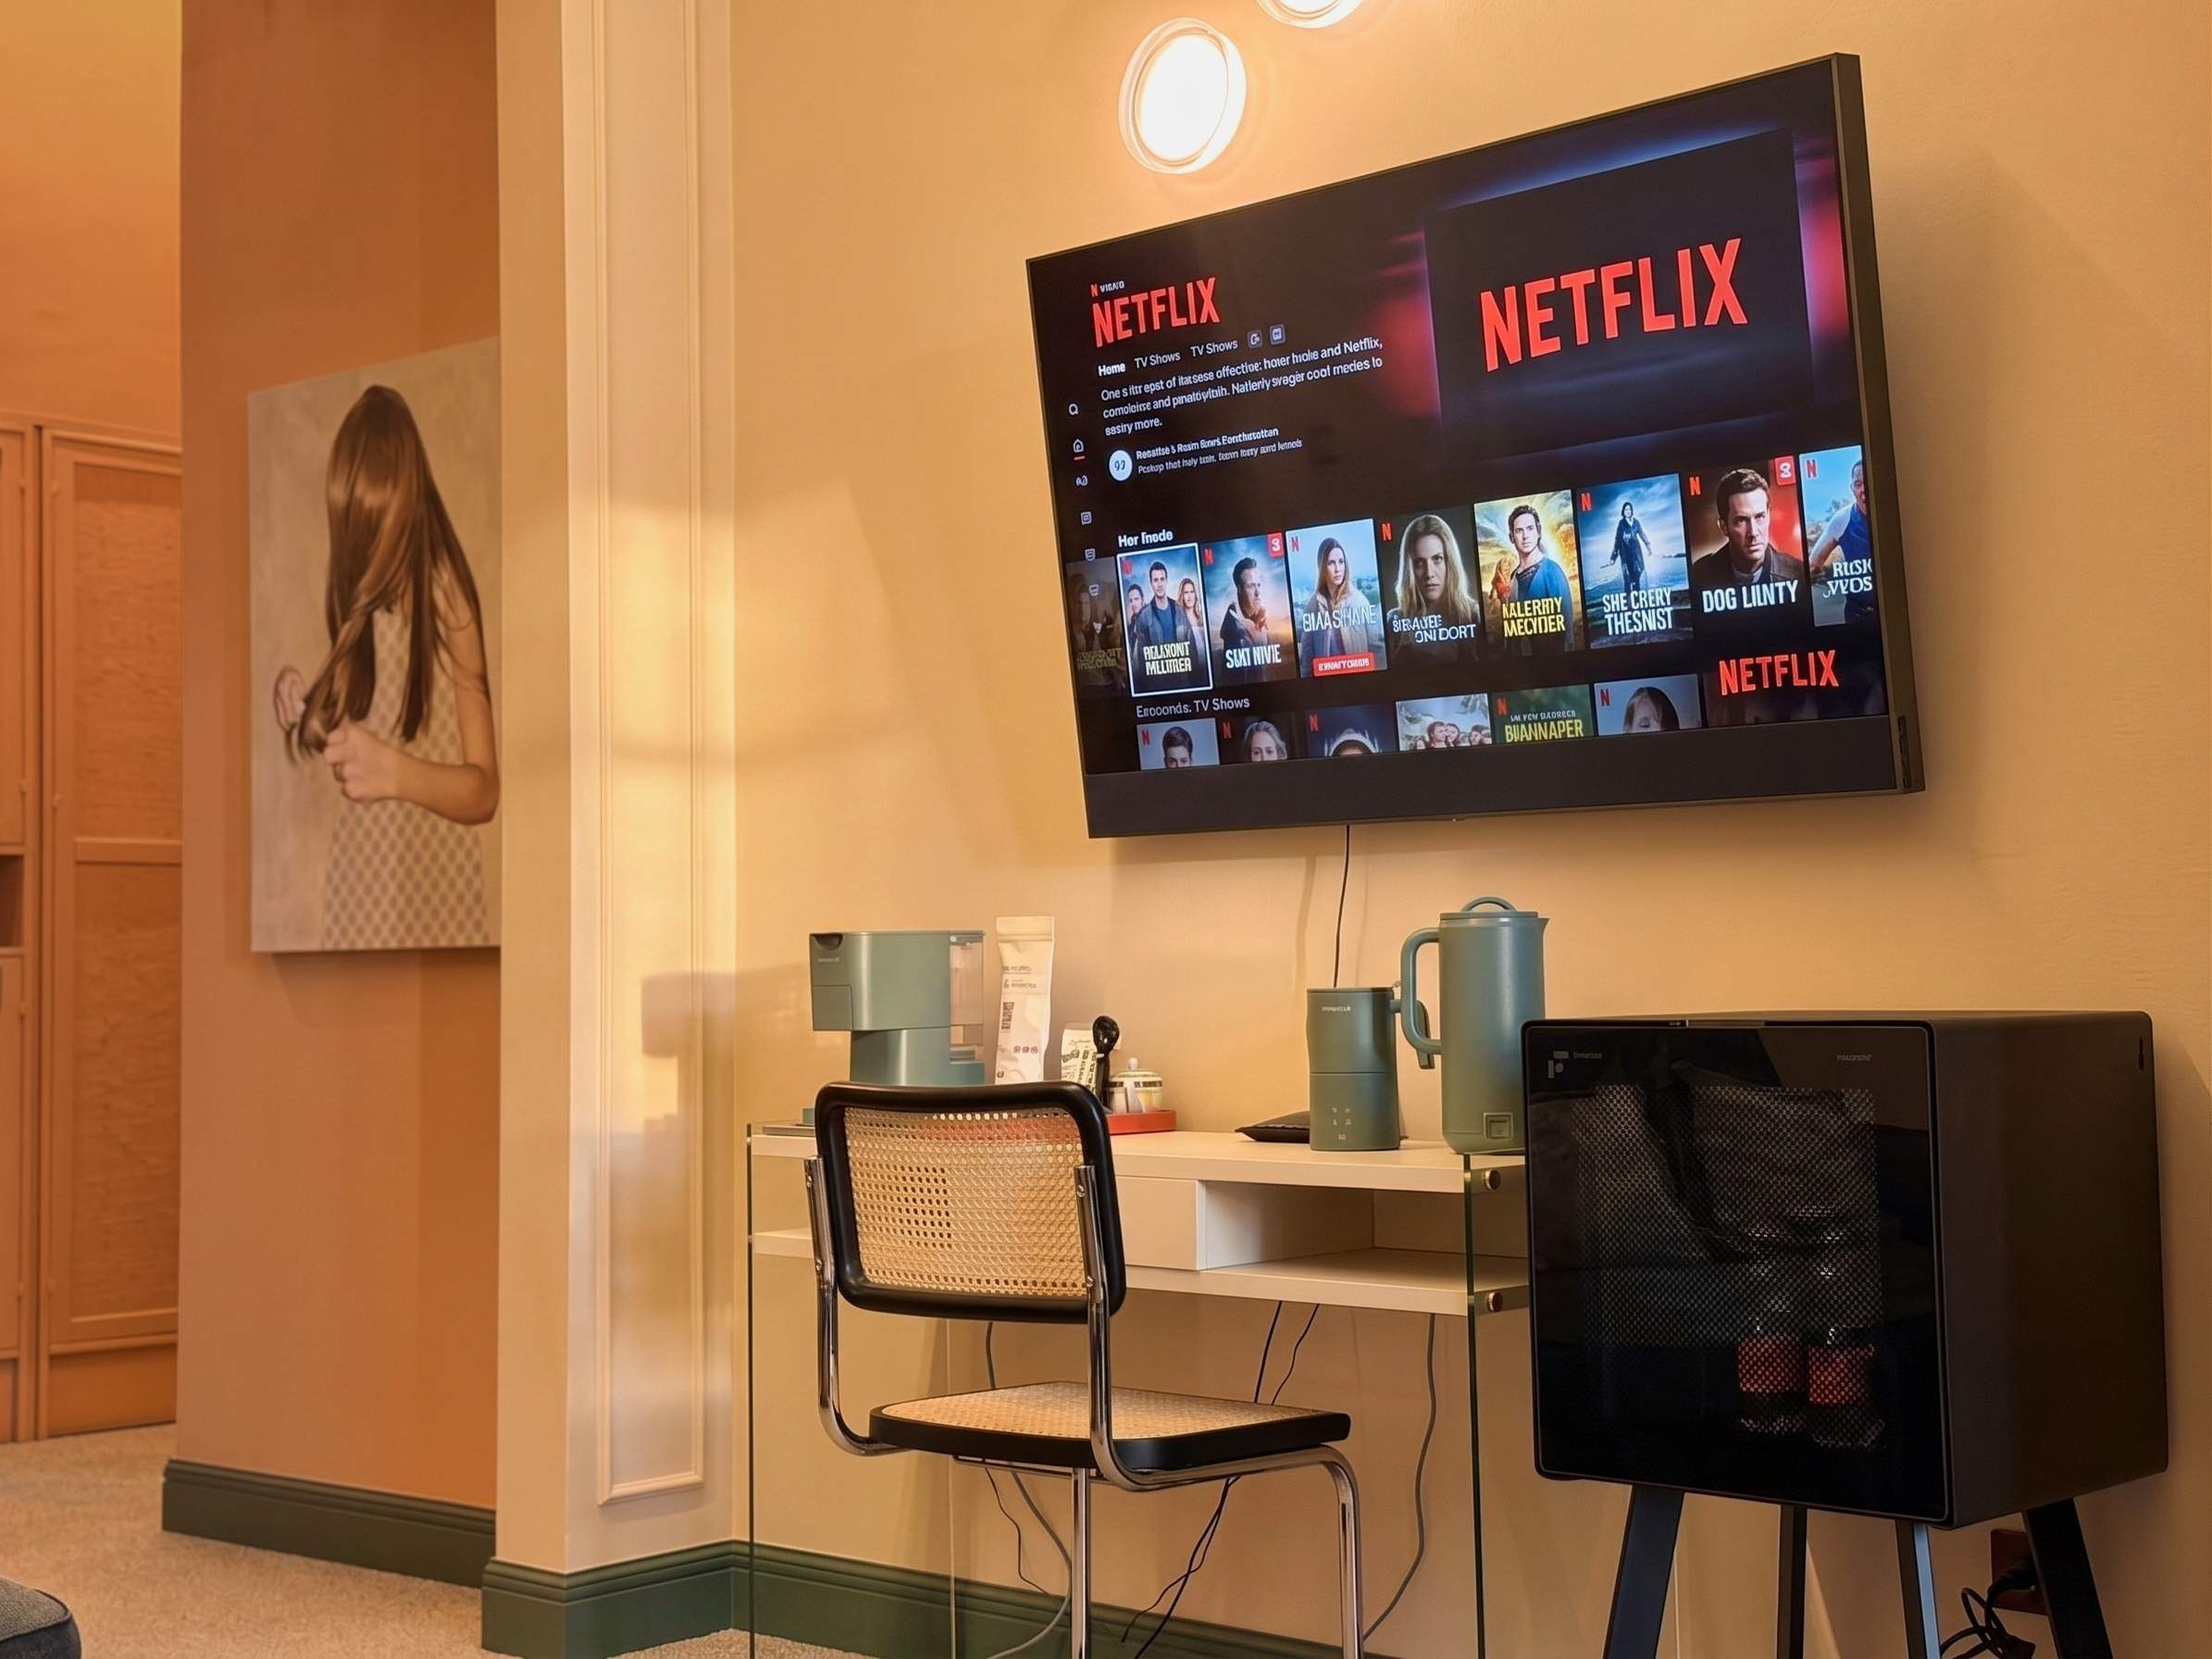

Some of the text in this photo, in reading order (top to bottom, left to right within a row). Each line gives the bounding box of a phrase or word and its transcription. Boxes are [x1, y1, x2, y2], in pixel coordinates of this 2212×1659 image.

[1092, 277, 1221, 348] NETFLIX
[1481, 238, 1747, 371] NETFLIX
[1190, 340, 1238, 357] TV Shows
[1098, 362, 1126, 377] Home
[1100, 390, 1121, 401] One
[1165, 377, 1176, 389] of
[1321, 343, 1341, 358] and
[1344, 337, 1383, 354] Netflix,
[1134, 352, 1181, 369] TV Shows
[1152, 395, 1171, 409] and
[1134, 418, 1162, 430] more.
[1689, 476, 1701, 495] N
[1581, 493, 1592, 511] N
[1381, 522, 1392, 541] N
[1602, 592, 1627, 613] SHE
[1702, 587, 1736, 614] DOG
[1719, 650, 1839, 695] NETFLIX
[1193, 700, 1210, 713] TV
[1212, 697, 1250, 712] Shows
[1600, 689, 1610, 706] N
[1309, 714, 1319, 731] N
